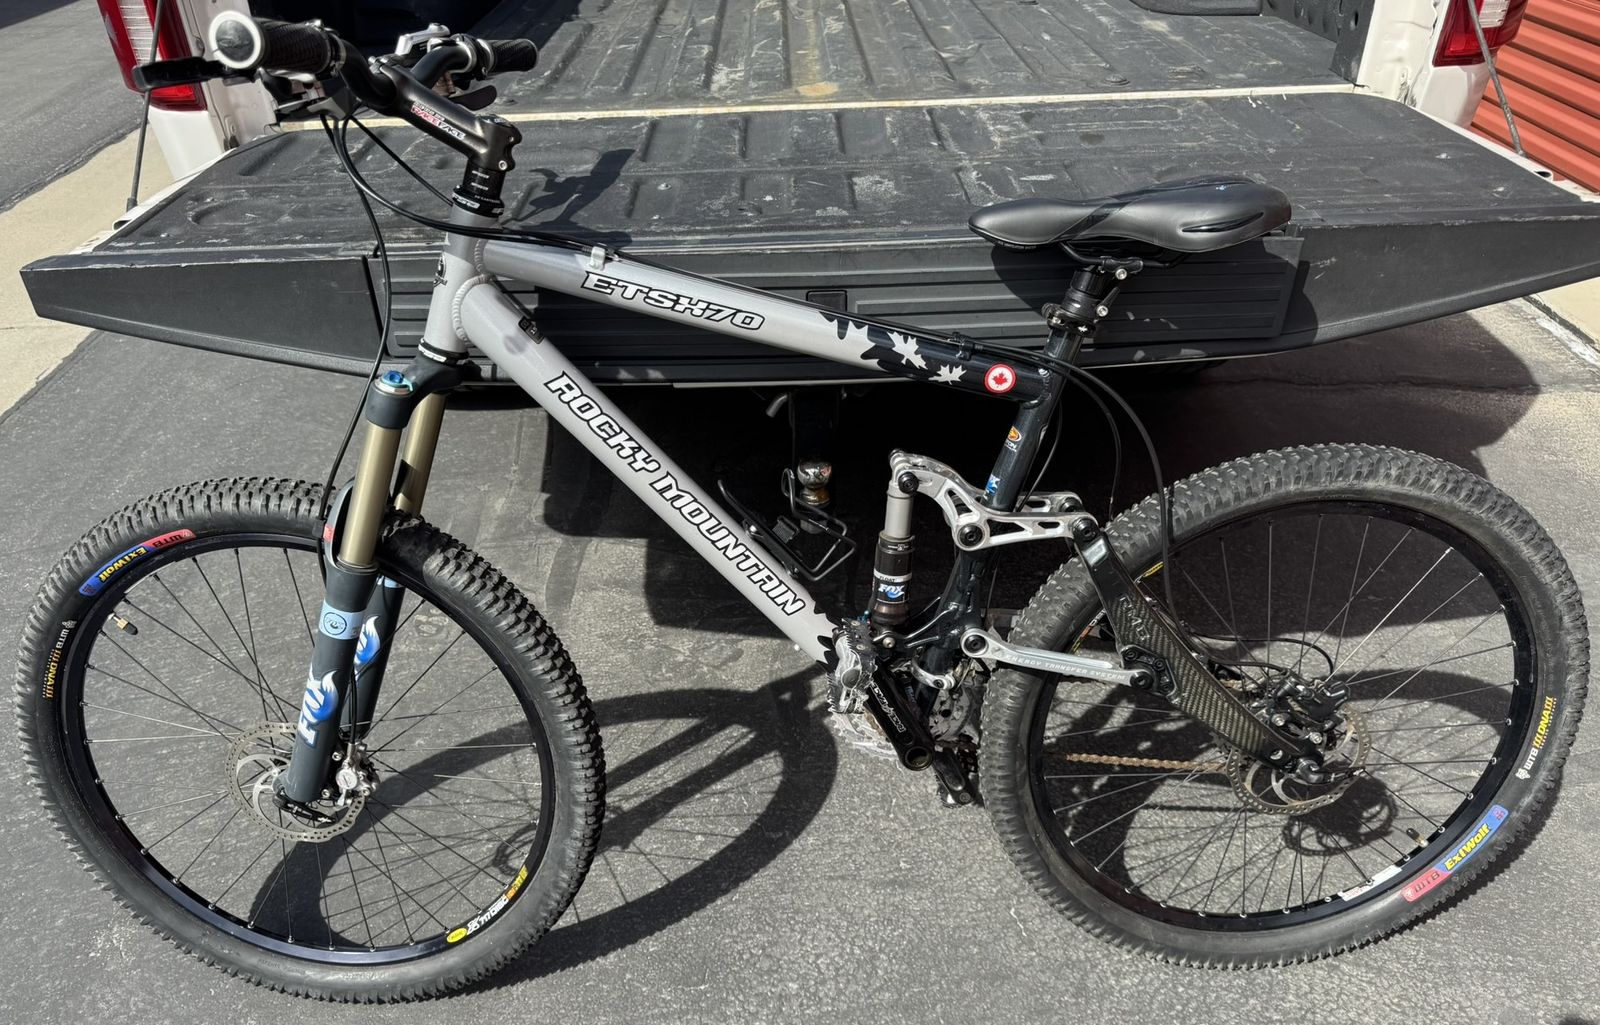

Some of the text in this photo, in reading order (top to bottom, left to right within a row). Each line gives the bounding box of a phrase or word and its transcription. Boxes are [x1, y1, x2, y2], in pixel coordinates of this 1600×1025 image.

[580, 270, 766, 331] ETSX70
[544, 371, 806, 616] ROCKY MOUNTAIN
[878, 583, 906, 598] FOX
[56, 629, 70, 649] WTB
[1005, 655, 1126, 679] ENERGY TRANSFER SYSTEM
[1523, 747, 1539, 770] WTB
